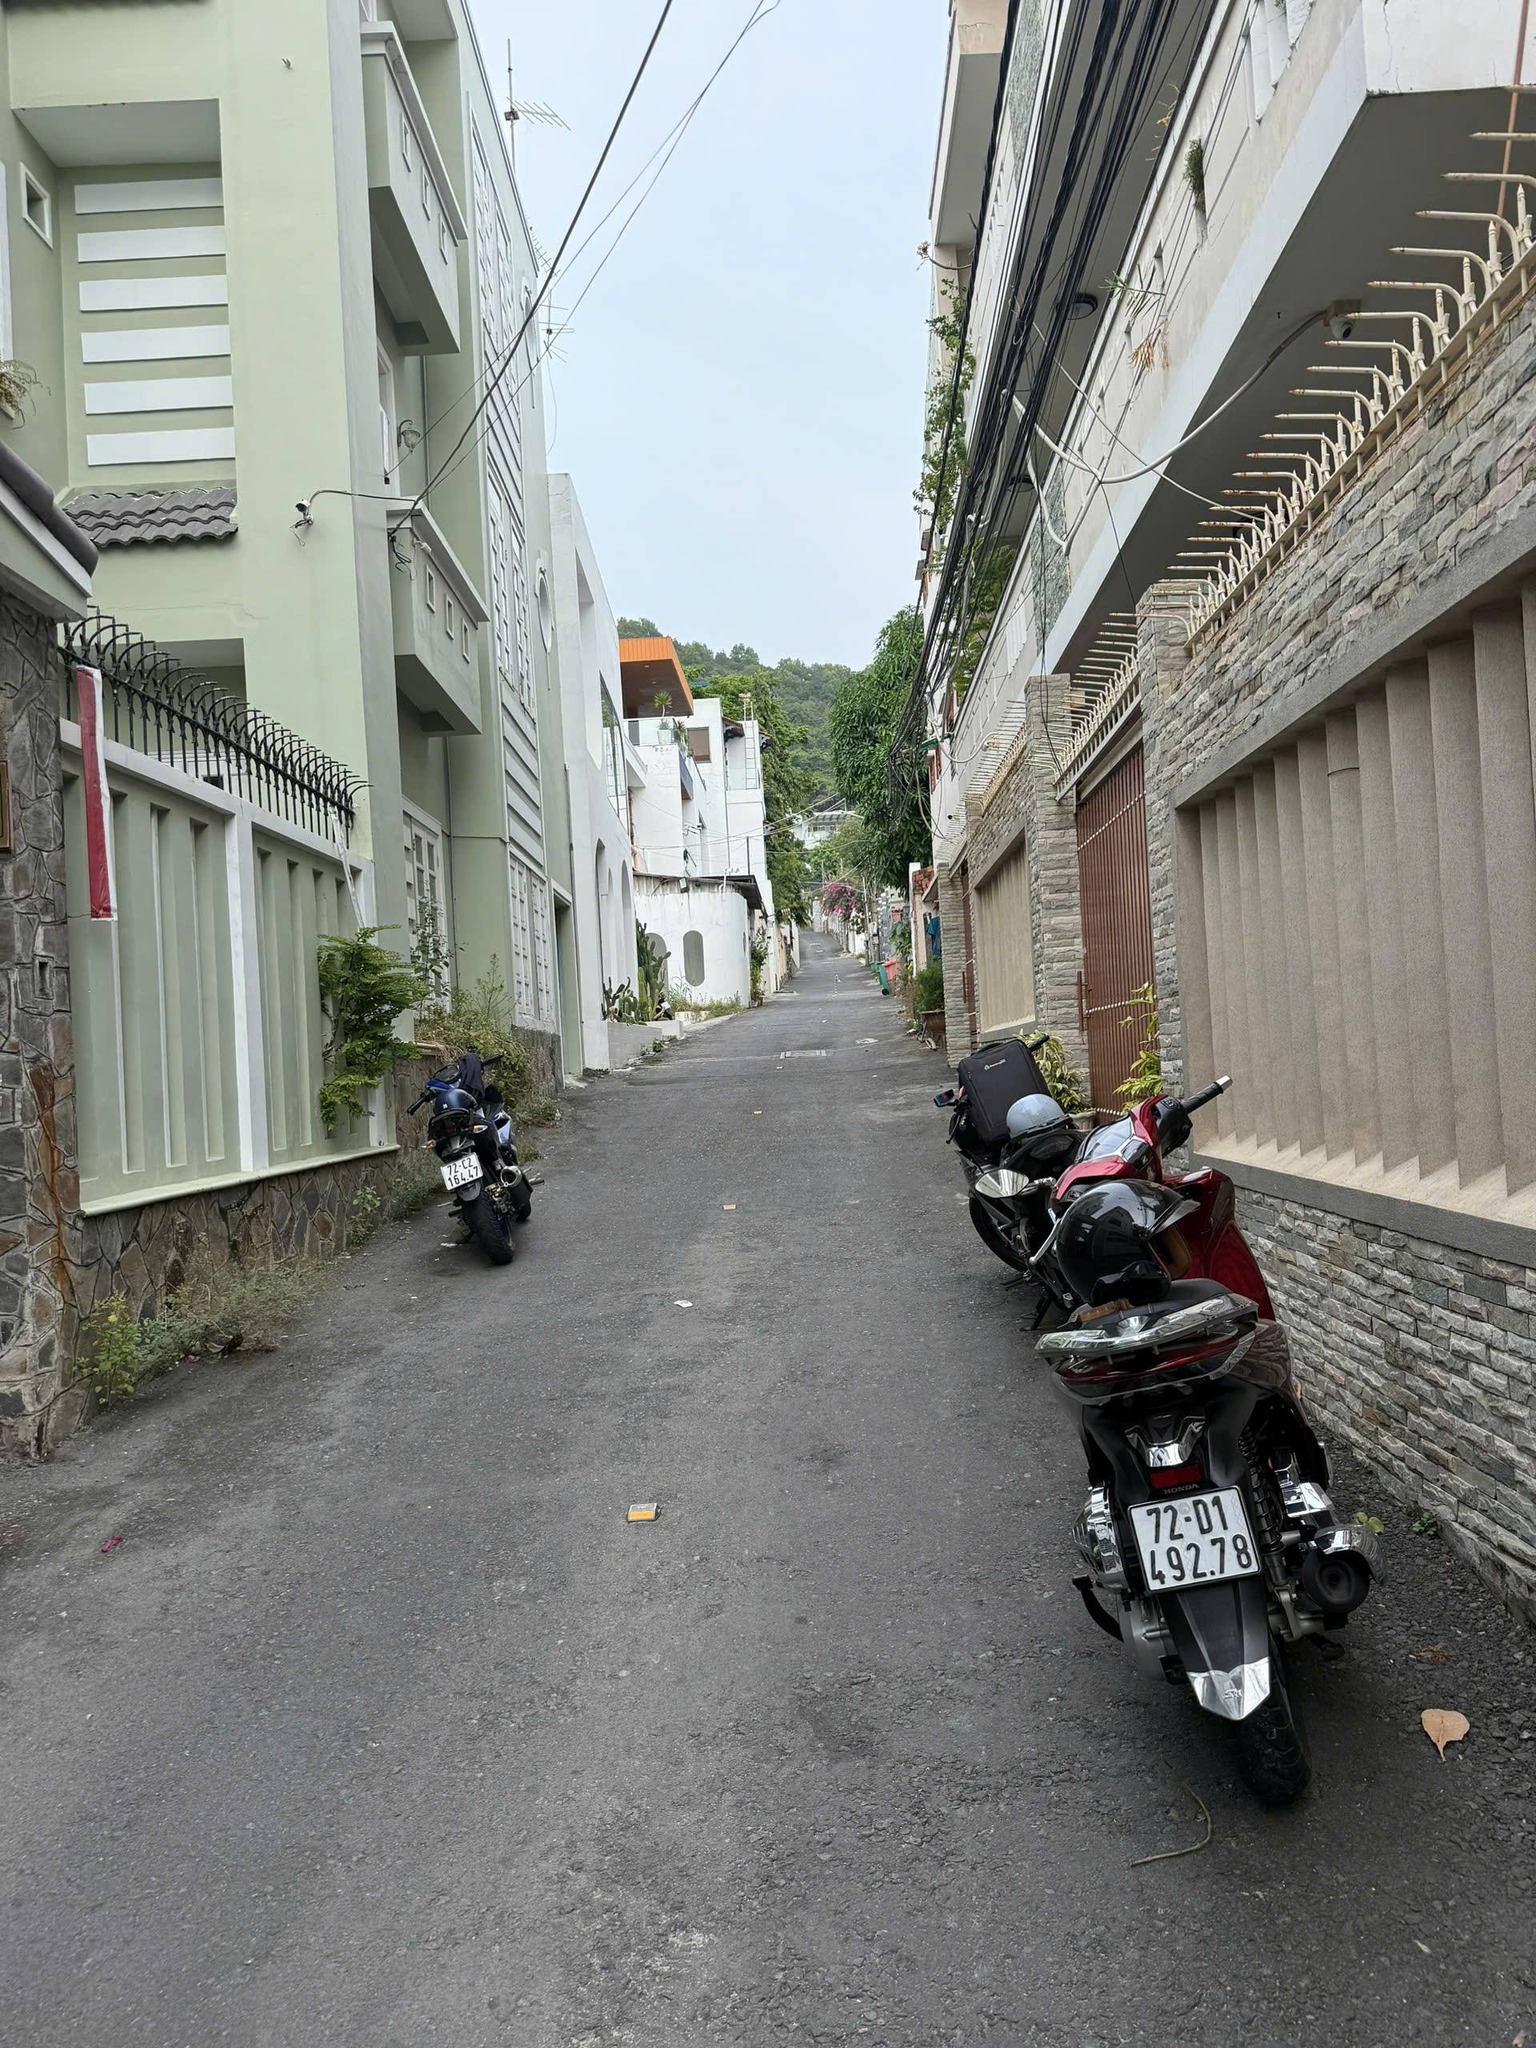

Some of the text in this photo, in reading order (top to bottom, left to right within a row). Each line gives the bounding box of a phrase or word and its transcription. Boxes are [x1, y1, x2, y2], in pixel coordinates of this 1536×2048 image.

[447, 1157, 473, 1176] 72-C2
[448, 1166, 478, 1187] 164.47
[1163, 1483, 1200, 1495] HONDA
[1146, 1495, 1229, 1544] 72-D1
[1150, 1534, 1252, 1584] 492.78
